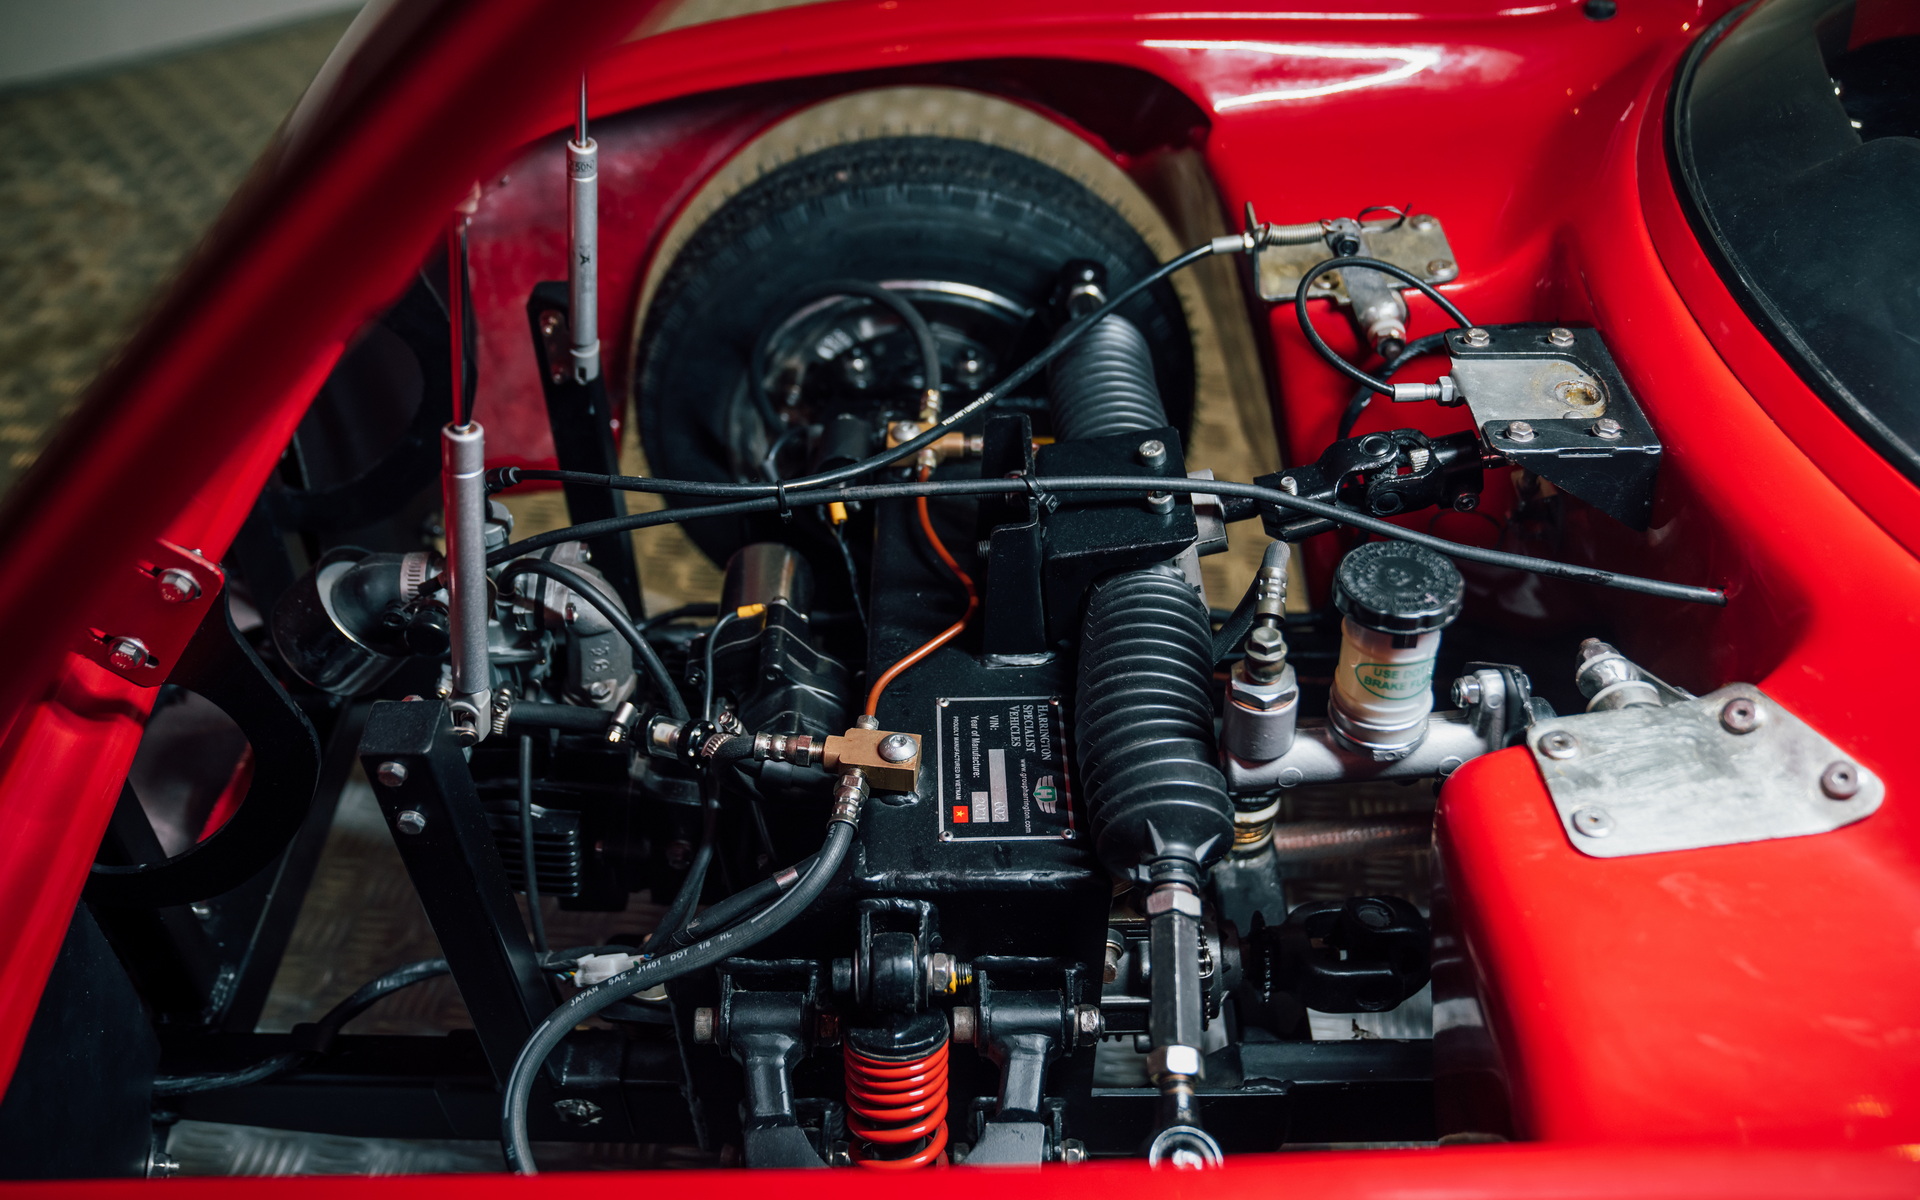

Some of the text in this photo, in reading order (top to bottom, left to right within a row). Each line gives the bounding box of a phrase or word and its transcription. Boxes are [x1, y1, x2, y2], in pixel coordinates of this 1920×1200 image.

[1363, 675, 1407, 691] BRAKE
[1374, 667, 1400, 679] USE
[970, 715, 980, 729] Year
[1009, 704, 1021, 747] VEHICLES
[1022, 704, 1036, 753] SPECIALIST
[1037, 704, 1052, 761] HARRINGTON
[971, 737, 981, 778] Manufacture:
[989, 714, 1006, 821] VIN: 002
[974, 797, 986, 821] 2021
[1020, 758, 1031, 834] www.groupharrington.com
[571, 985, 599, 1007] JAPAN
[608, 972, 627, 986] SAE
[636, 959, 661, 974] J1401
[670, 949, 689, 961] DOT
[720, 932, 732, 941] HL
